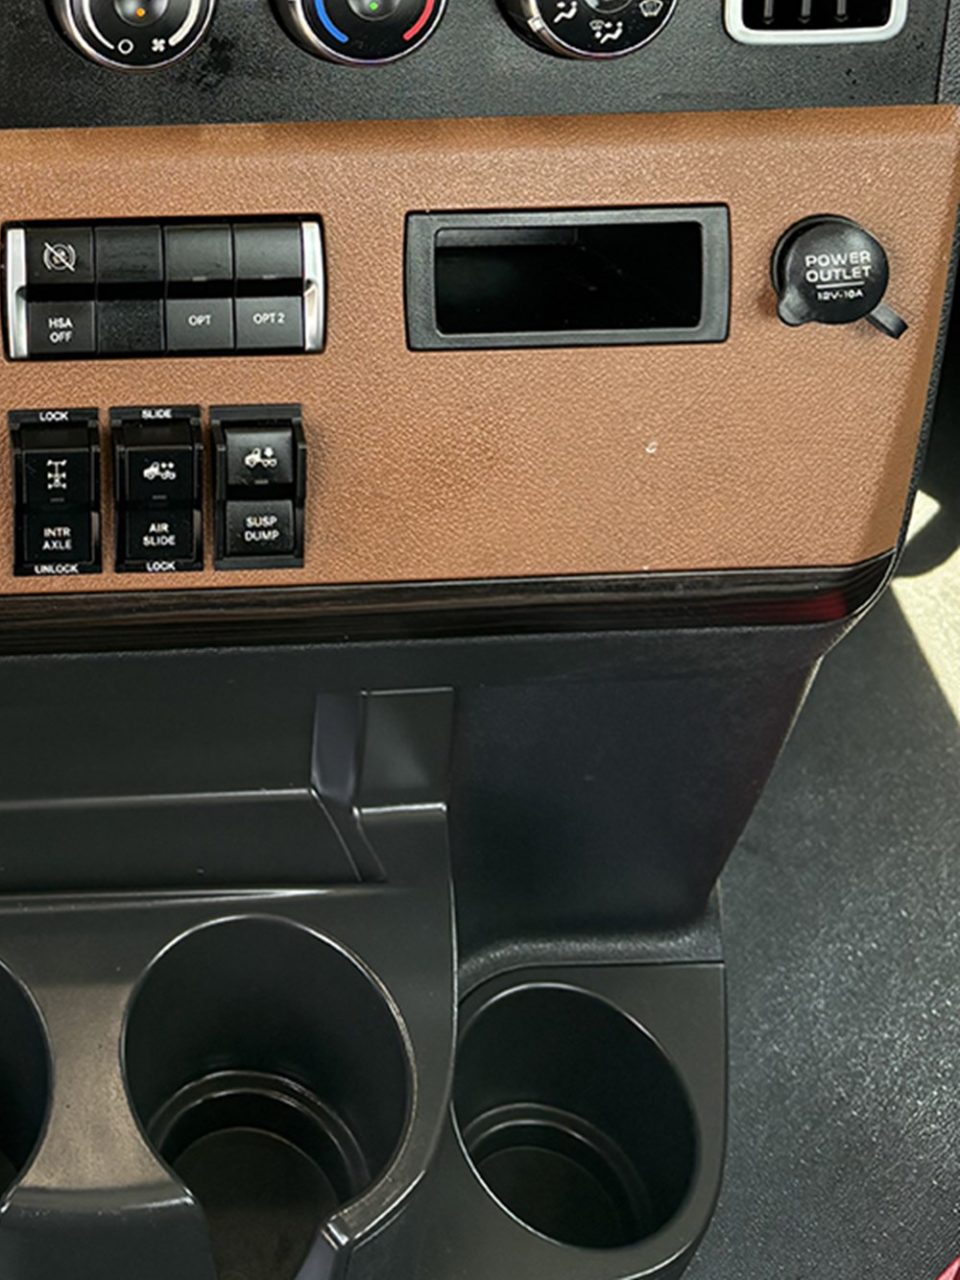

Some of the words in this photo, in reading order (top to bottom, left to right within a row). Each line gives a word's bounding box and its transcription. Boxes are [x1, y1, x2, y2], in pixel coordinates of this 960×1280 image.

[805, 250, 871, 267] POWER
[806, 265, 872, 283] OUTLET
[48, 317, 73, 329] HSA
[188, 314, 211, 326] OPT
[253, 313, 275, 325] OPT
[276, 313, 285, 324] 2
[50, 331, 72, 343] OFF
[39, 411, 69, 422] LOCK
[141, 408, 172, 420] SLIDE
[246, 516, 278, 528] SUSP
[43, 527, 71, 539] INTR
[148, 523, 170, 534] AIR
[143, 535, 176, 547] SLIDE
[244, 529, 280, 543] DUMP
[42, 539, 72, 551] AXLE
[34, 563, 79, 574] UNLOCK
[146, 561, 176, 572] LOCK
